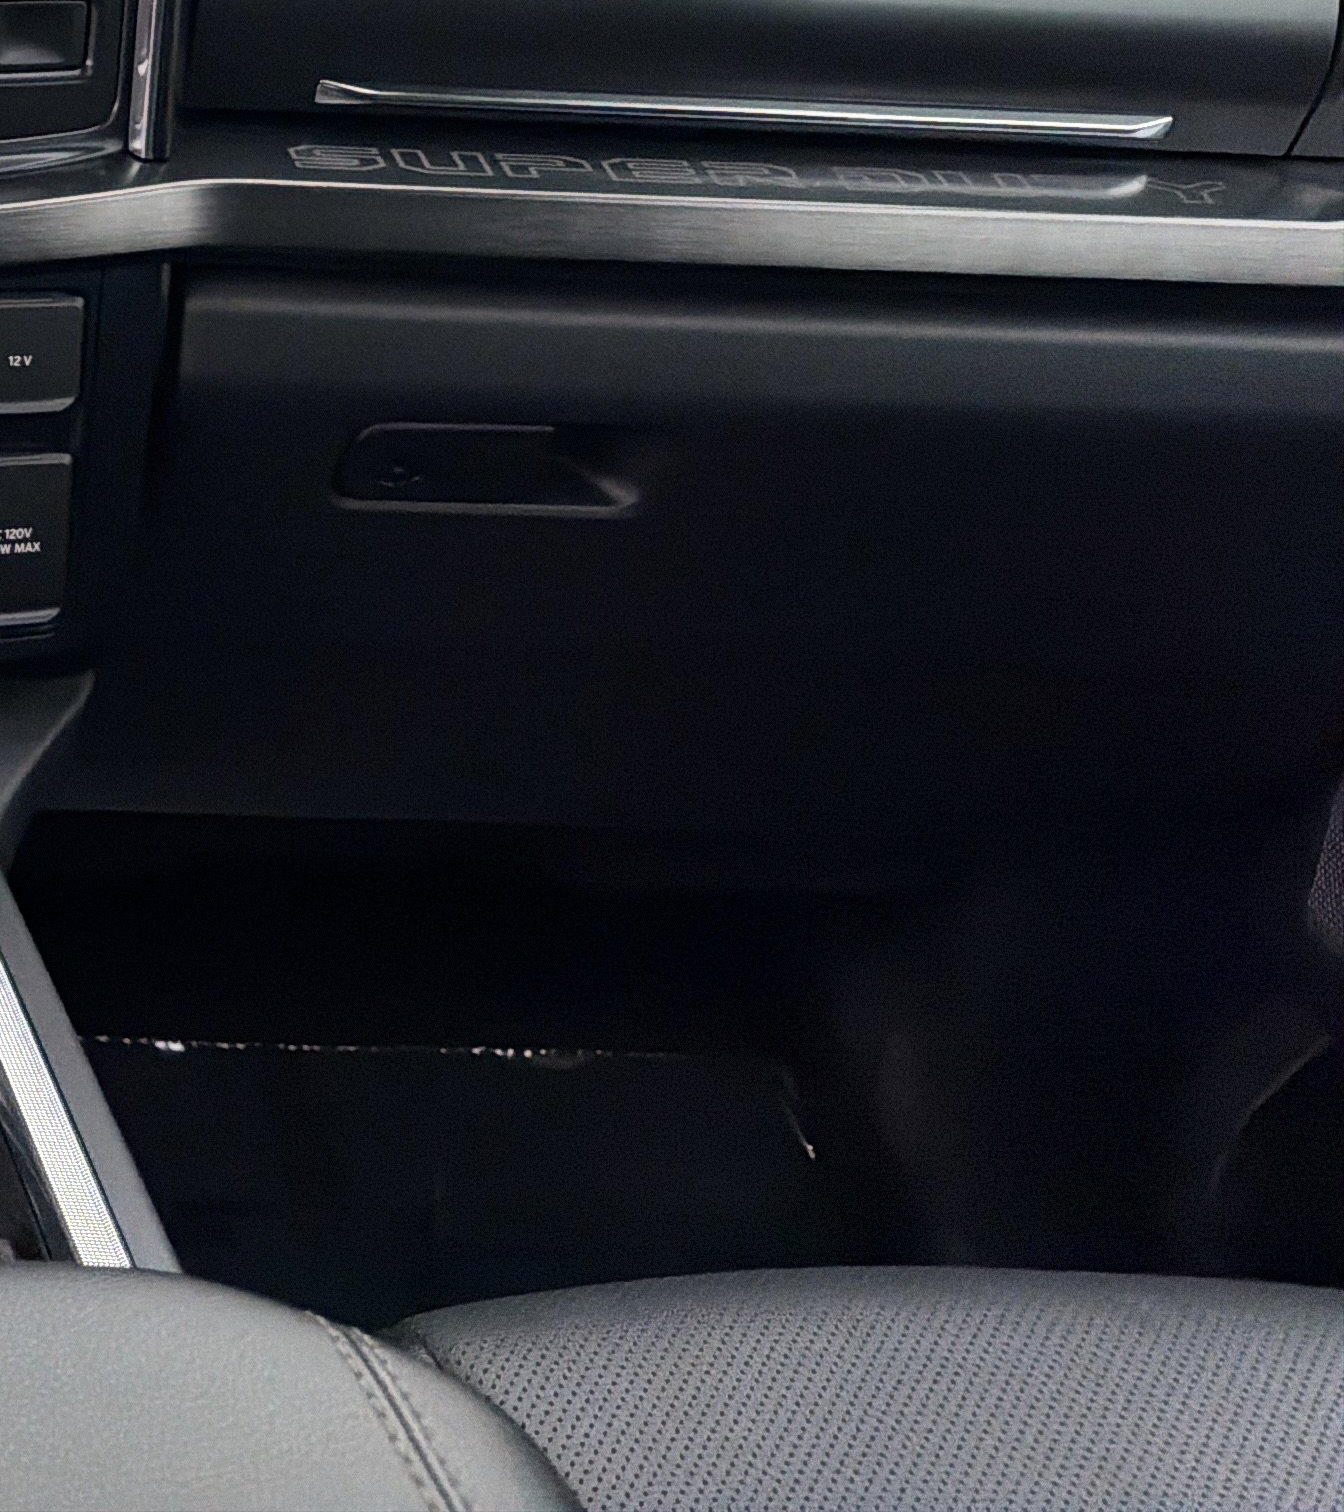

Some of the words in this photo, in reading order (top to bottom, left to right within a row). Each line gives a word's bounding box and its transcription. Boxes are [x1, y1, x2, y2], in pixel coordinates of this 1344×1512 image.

[288, 144, 798, 186] SUPER
[832, 166, 1226, 205] DUY
[8, 354, 22, 367] 12
[23, 354, 33, 367] V
[3, 527, 33, 541] 120V
[13, 541, 41, 555] MAX
